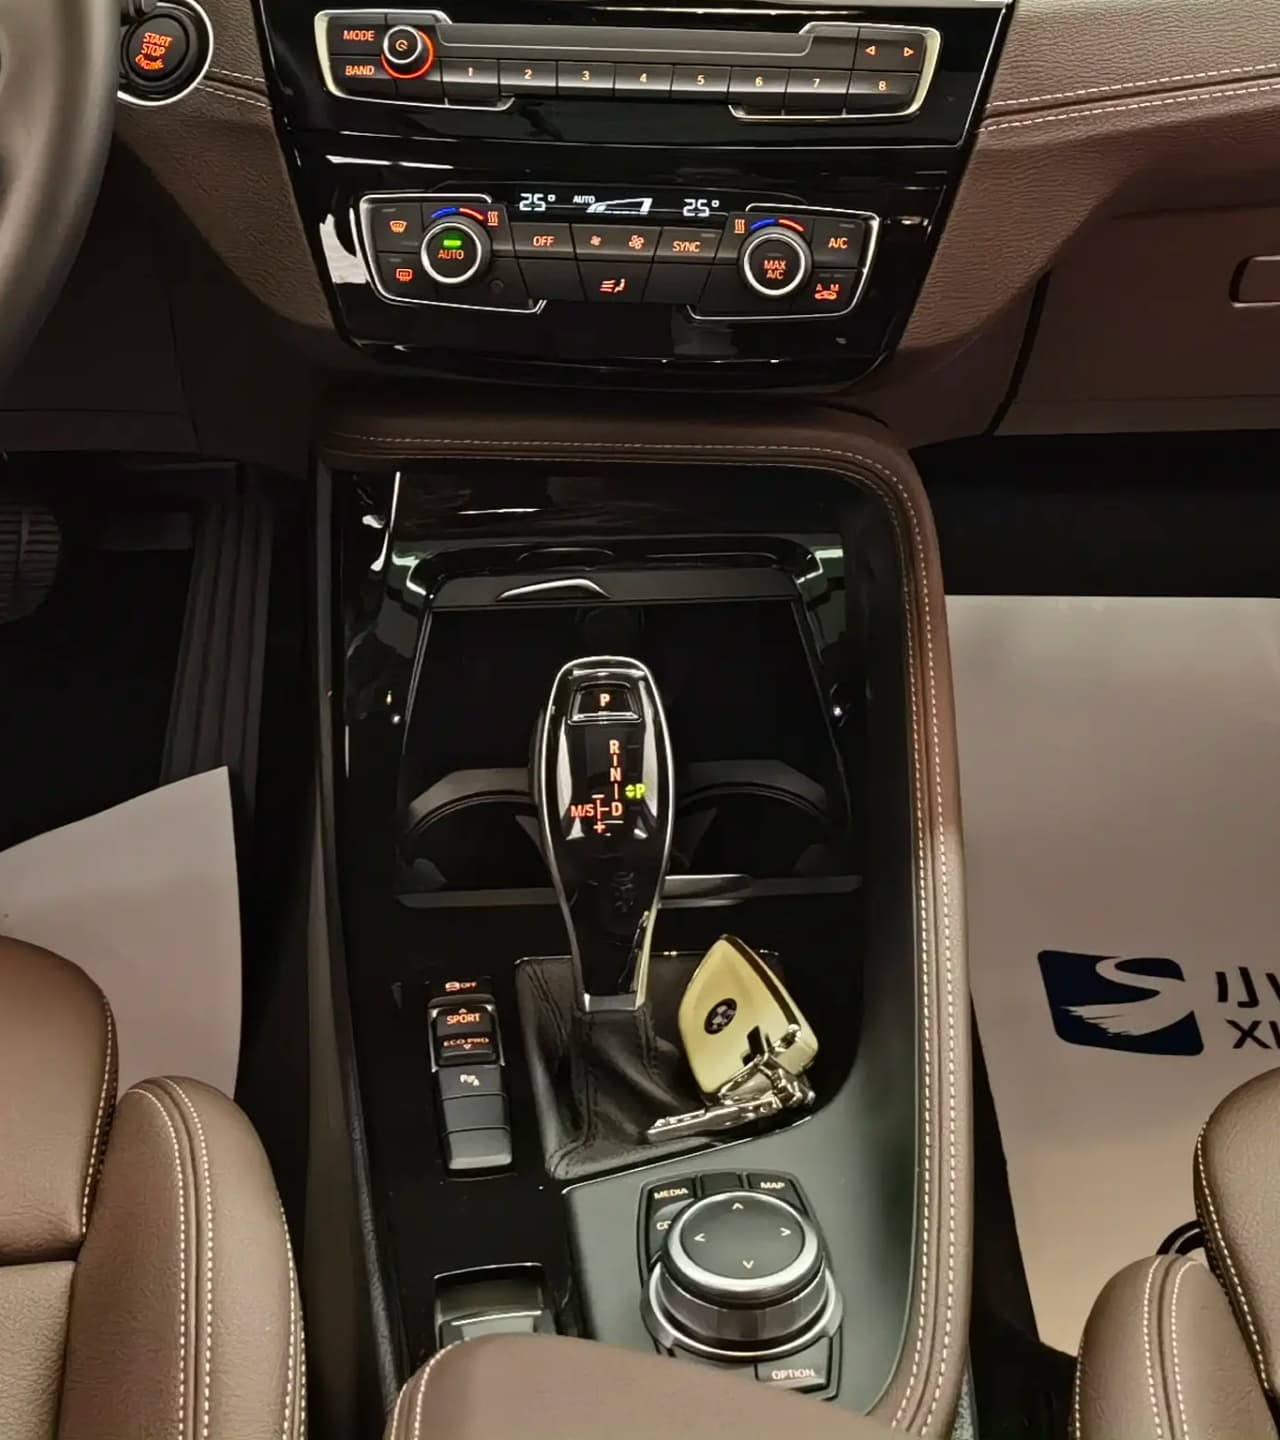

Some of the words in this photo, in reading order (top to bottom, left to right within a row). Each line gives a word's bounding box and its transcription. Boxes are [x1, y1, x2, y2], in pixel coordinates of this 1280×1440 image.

[143, 32, 173, 47] START
[342, 30, 376, 41] MODE
[140, 43, 166, 57] STOP
[344, 65, 376, 76] BAND
[467, 67, 474, 77] 1
[524, 68, 533, 80] 2
[581, 70, 590, 81] 3
[639, 72, 648, 84] 4
[696, 74, 705, 85] 5
[754, 76, 764, 87] 6
[812, 78, 821, 88] 7
[878, 80, 887, 91] 8
[572, 195, 595, 204] AUTO
[532, 235, 555, 247] OFF
[672, 241, 701, 253] SYNC
[827, 237, 848, 249] A/C
[437, 249, 465, 260] AUTO
[763, 260, 787, 270] MAX
[766, 269, 785, 280] A/C
[599, 693, 611, 707] P
[608, 739, 620, 754] R
[609, 767, 622, 782] N
[635, 783, 646, 799] P
[570, 803, 595, 817] M/S
[611, 801, 623, 817] D
[446, 1012, 481, 1025] SPORT
[443, 1038, 466, 1047] ECO
[466, 1036, 490, 1044] PRO
[760, 1180, 786, 1189] MAP
[654, 1187, 689, 1200] MEDIA
[771, 1367, 817, 1380] OPTION
